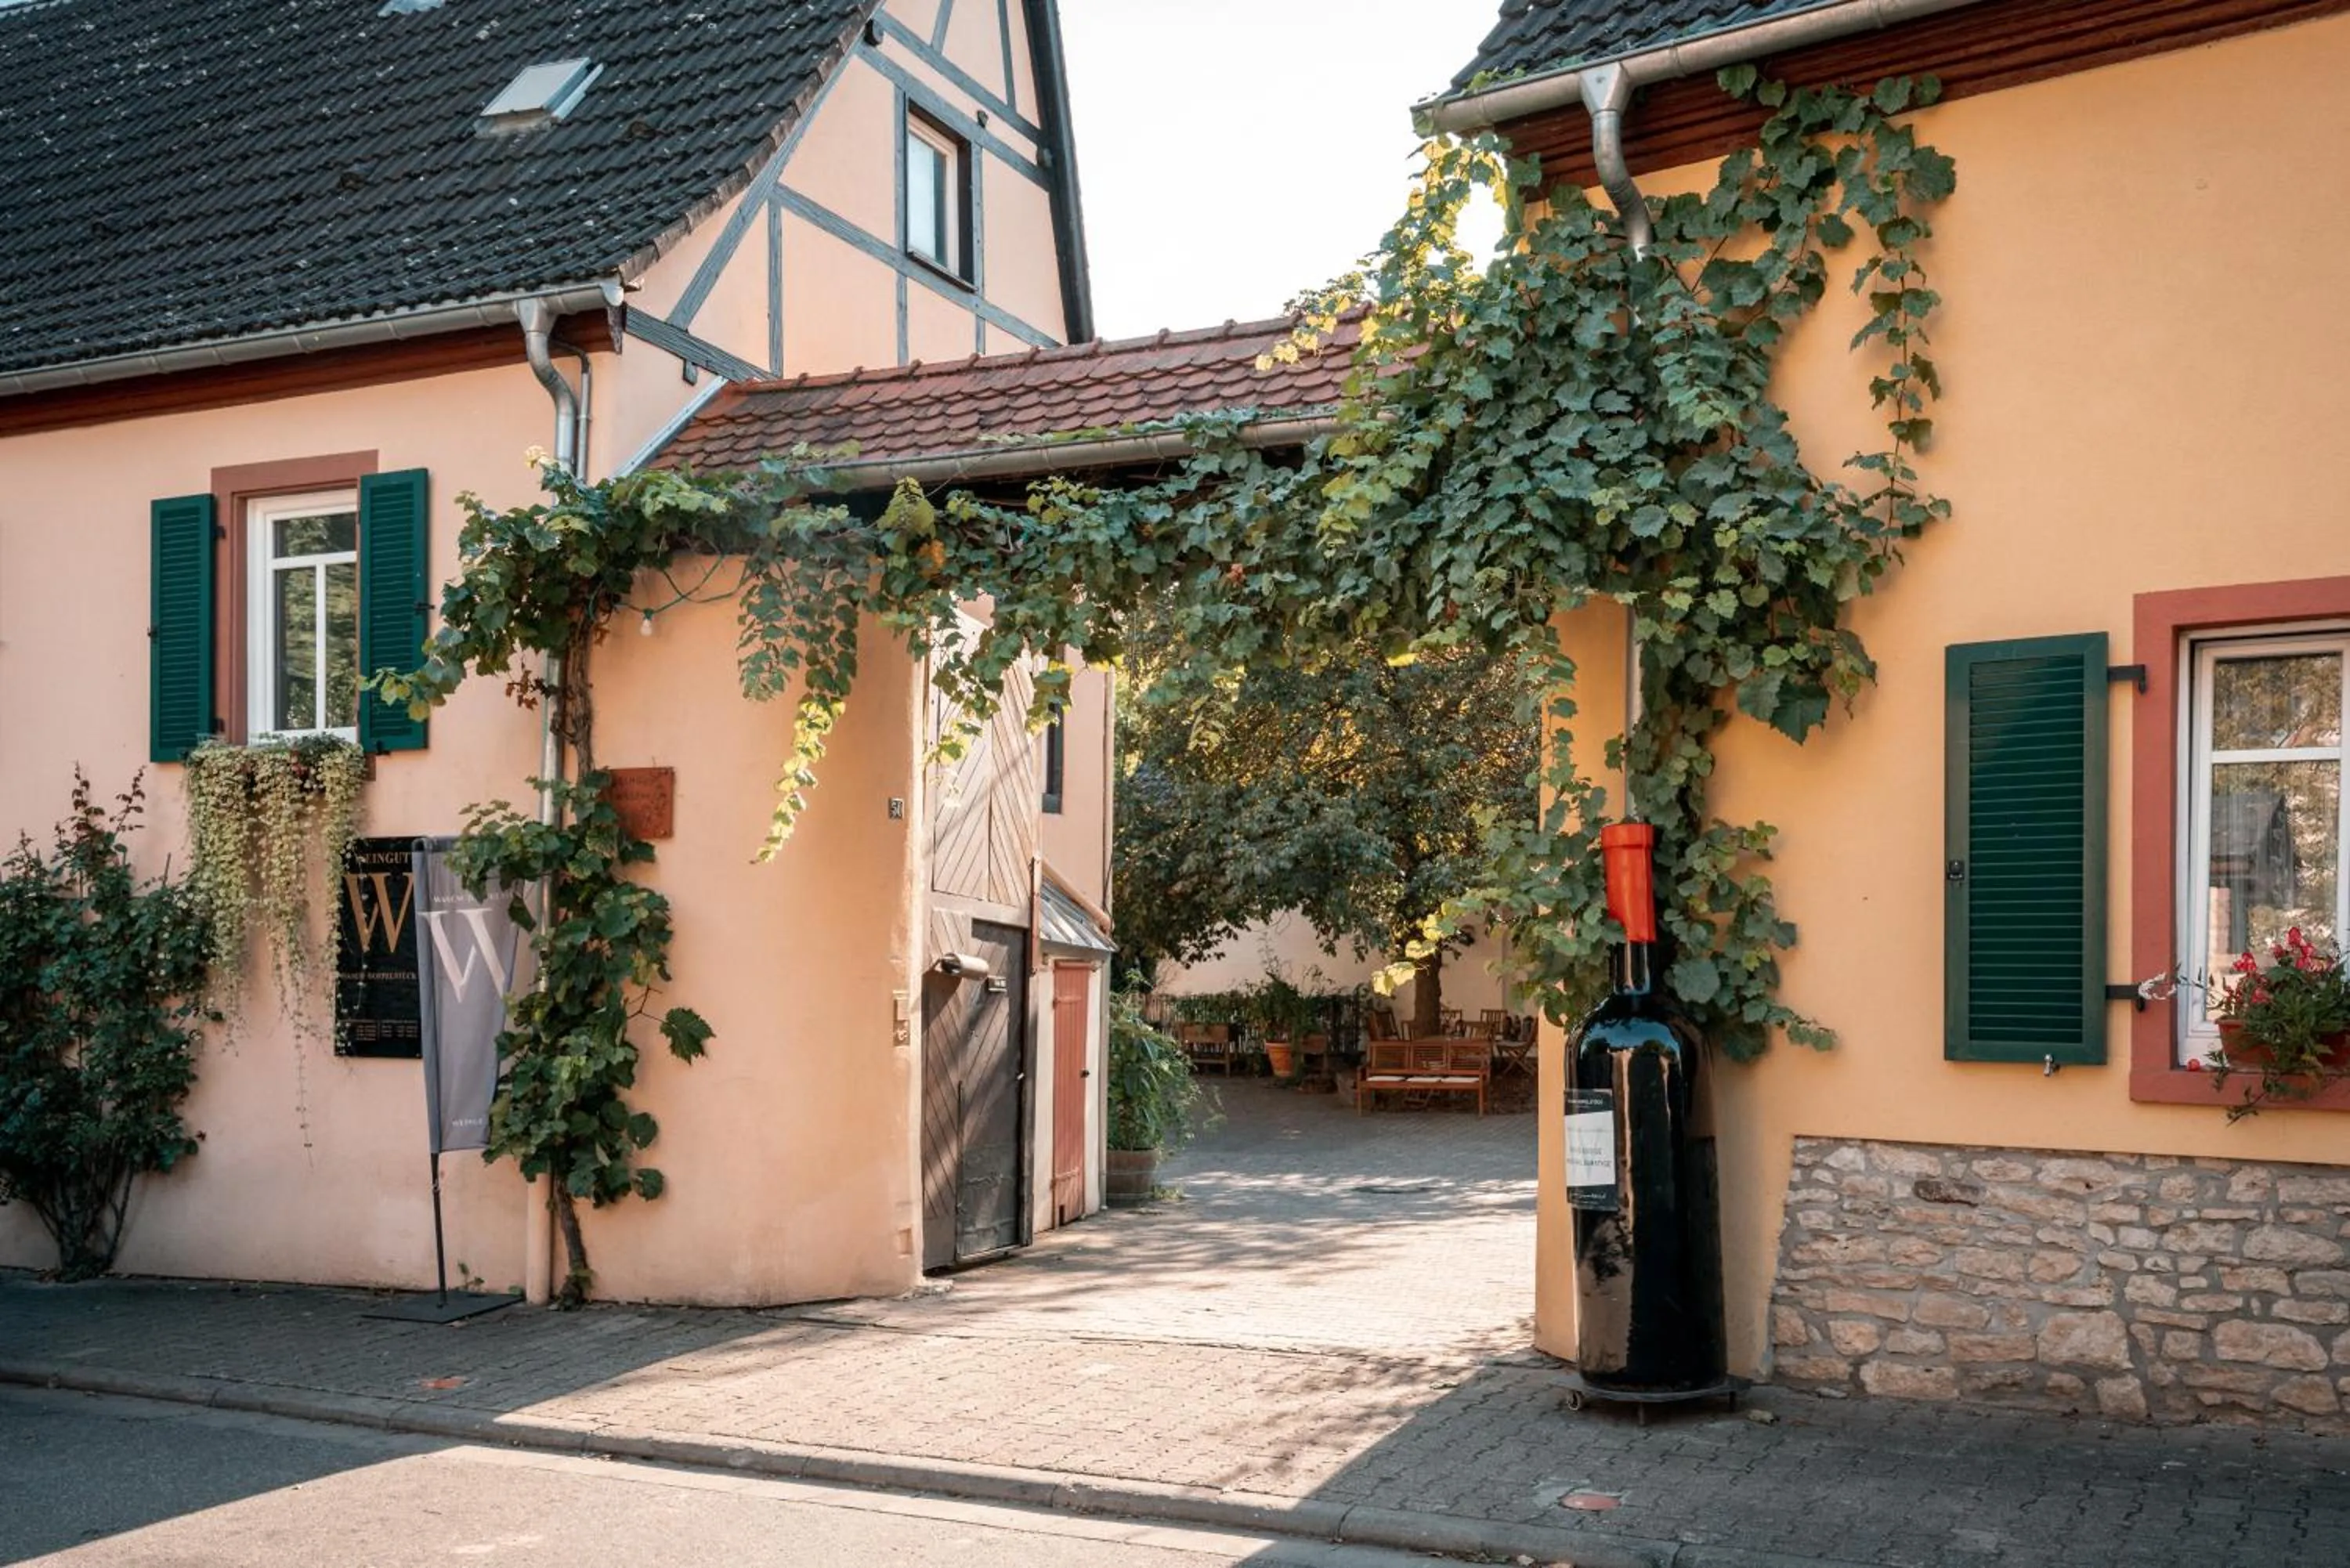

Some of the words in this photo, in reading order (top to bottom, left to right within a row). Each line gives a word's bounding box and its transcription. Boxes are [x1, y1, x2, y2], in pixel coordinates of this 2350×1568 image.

[355, 851, 410, 863] EINGUT
[342, 872, 414, 953] W
[417, 908, 508, 1003] W
